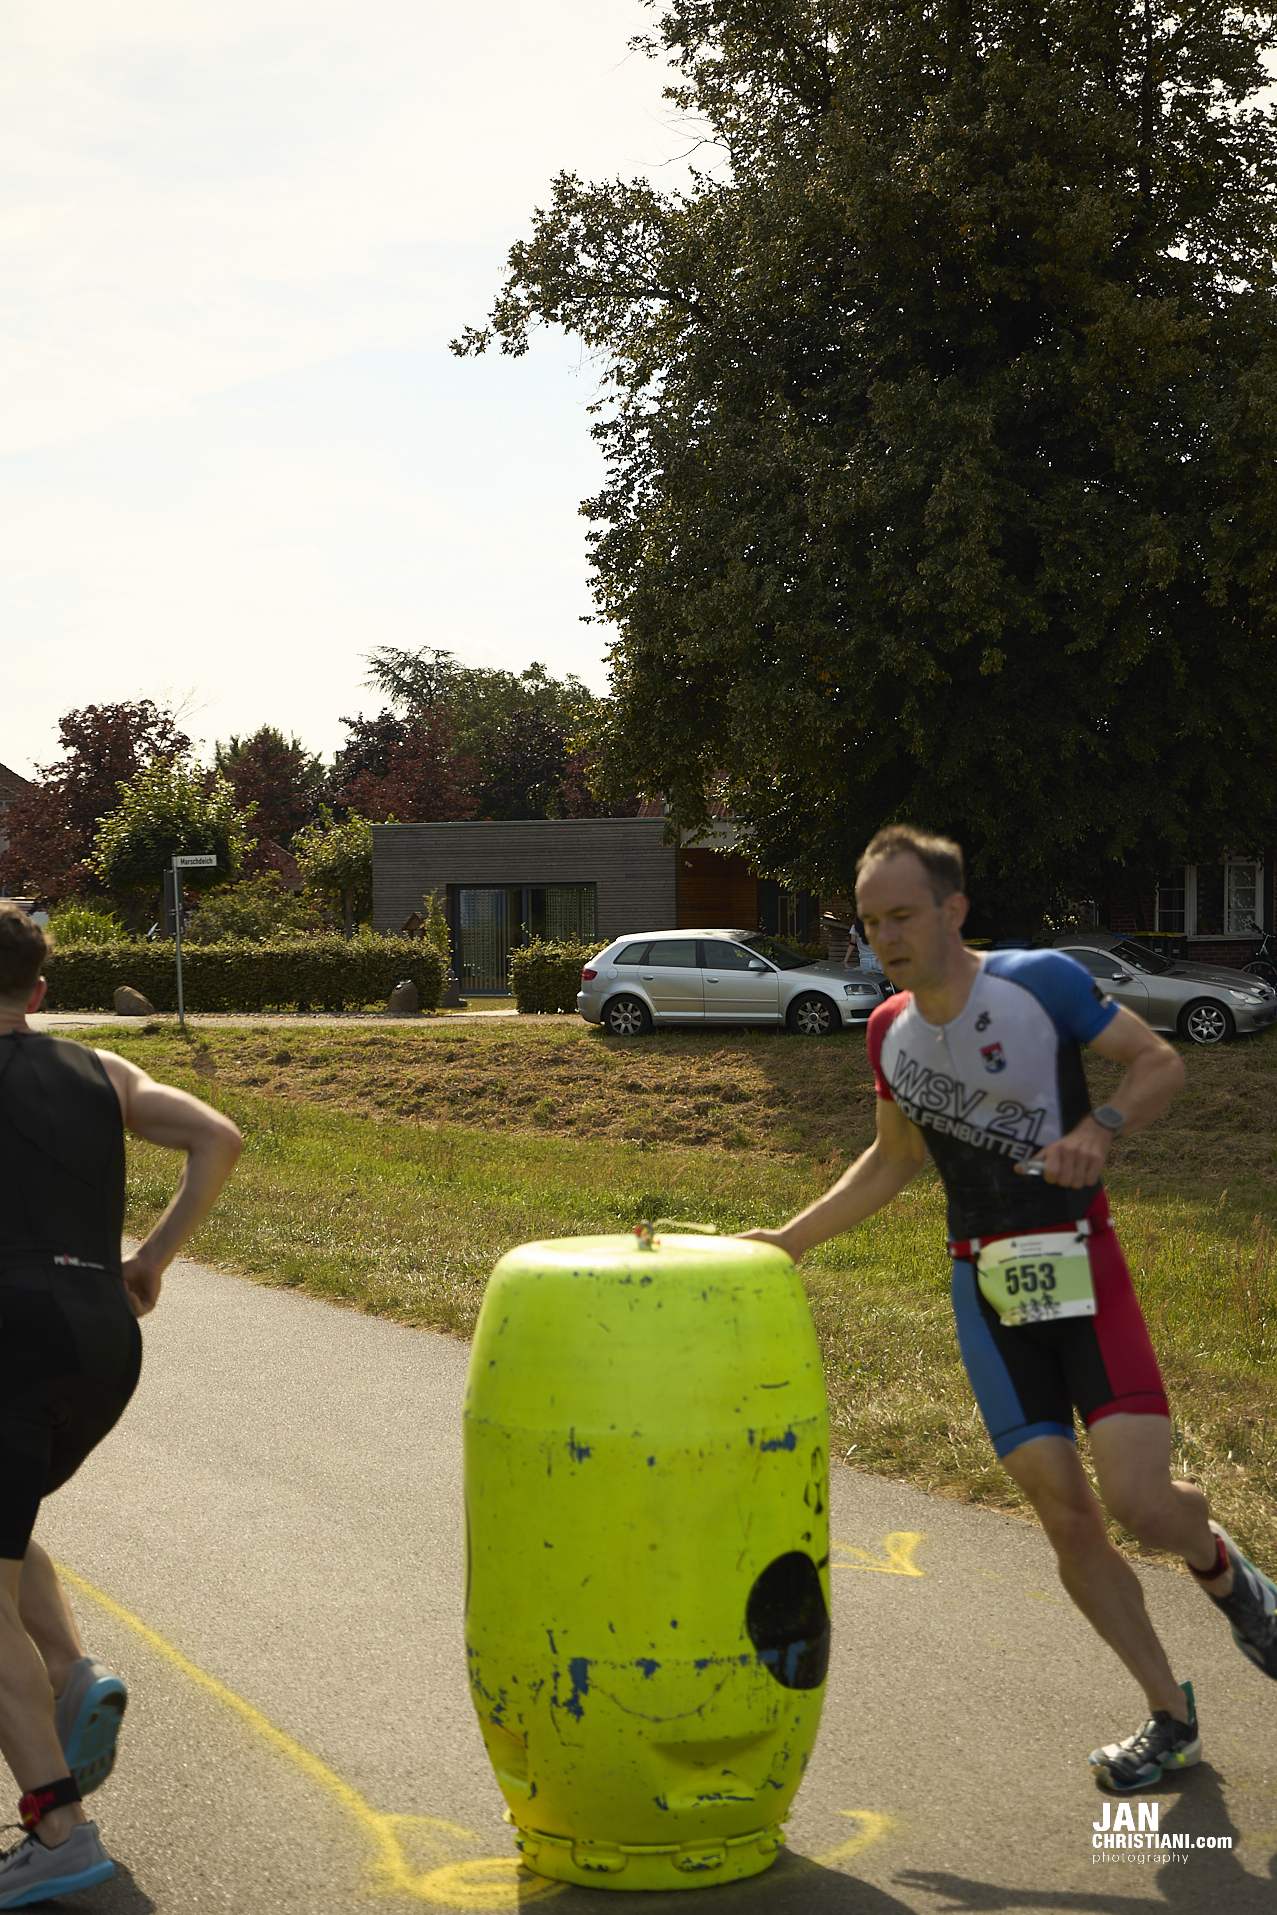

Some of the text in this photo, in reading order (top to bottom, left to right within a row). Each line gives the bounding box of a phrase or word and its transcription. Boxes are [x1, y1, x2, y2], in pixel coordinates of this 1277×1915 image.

[180, 857, 213, 866] Marschdeich
[892, 1050, 1047, 1144] WSV 21
[893, 1093, 1035, 1163] OLFENBÜTTEL
[1004, 1262, 1057, 1296] 553
